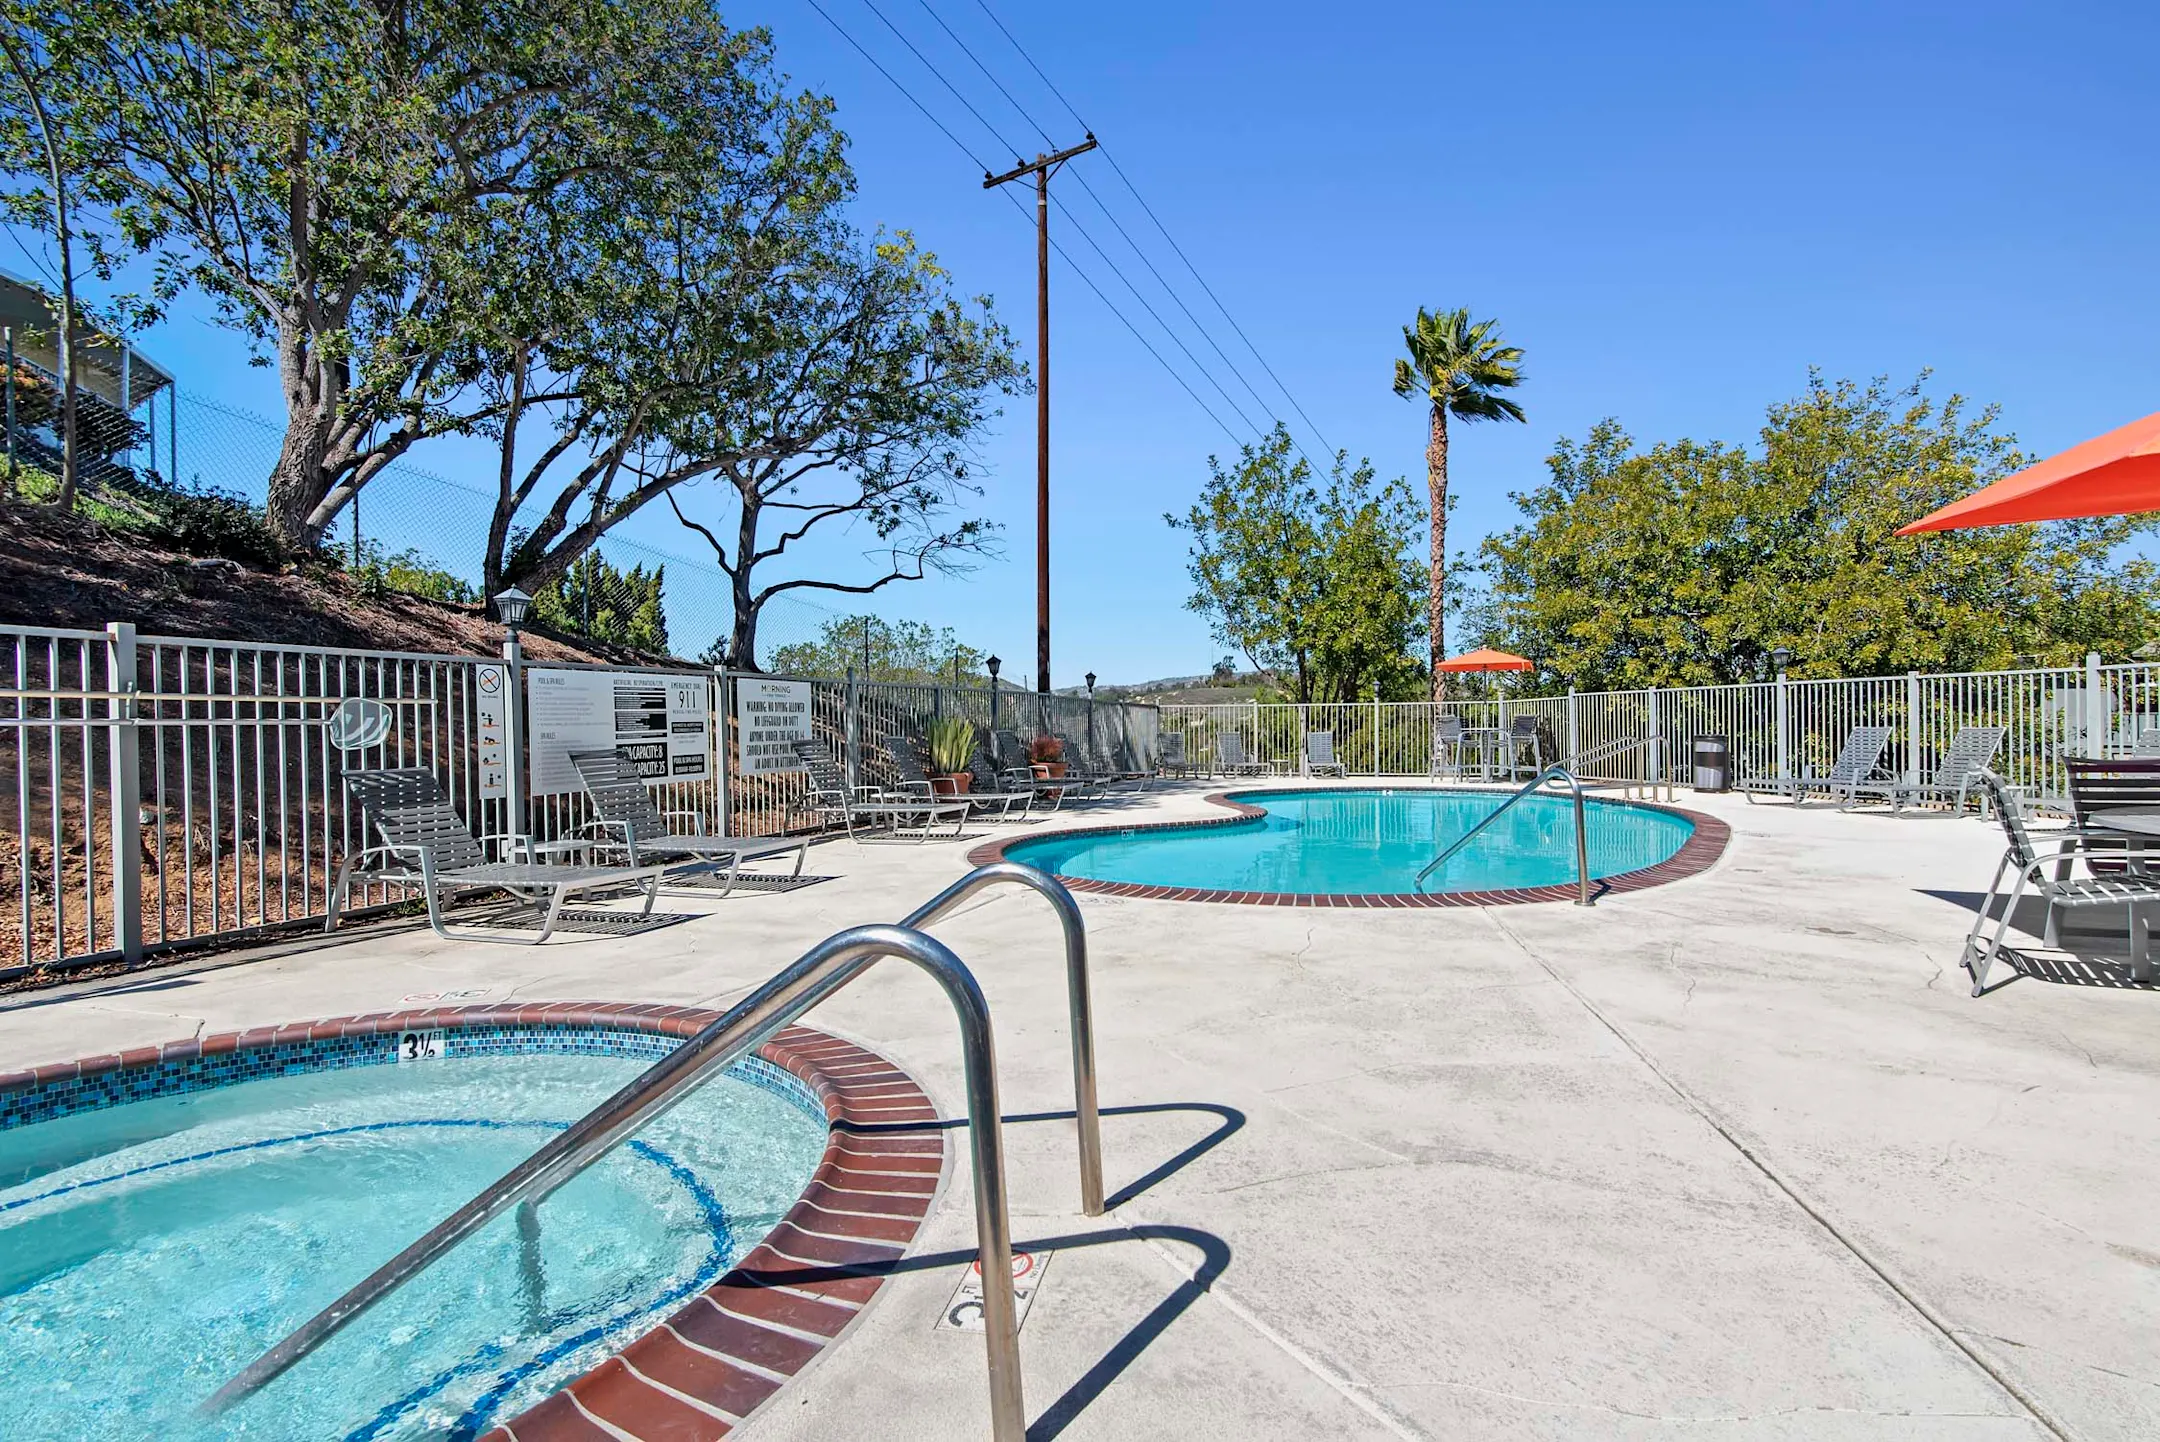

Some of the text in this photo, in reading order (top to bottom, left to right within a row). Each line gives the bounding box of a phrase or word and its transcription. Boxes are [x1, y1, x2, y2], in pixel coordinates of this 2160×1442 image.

[670, 682, 692, 690] EMERGENCY
[678, 690, 696, 709] 911
[768, 701, 774, 713] NO
[774, 701, 788, 713] DIVING
[788, 702, 805, 713] ALLOWED
[754, 715, 799, 727] NO LIFEGUARD ON DUTY
[749, 731, 764, 742] ANYONE
[765, 731, 778, 742] UNDER
[786, 730, 794, 741] AGE
[794, 730, 800, 741] OF
[746, 744, 762, 756] SHOULD
[762, 744, 771, 755] NOT
[771, 743, 779, 755] USE
[780, 743, 789, 755] POOL
[658, 760, 666, 774] 25
[754, 758, 761, 769] AN
[761, 757, 774, 769] ADULT
[774, 757, 779, 768] IN
[433, 1030, 442, 1040] FT
